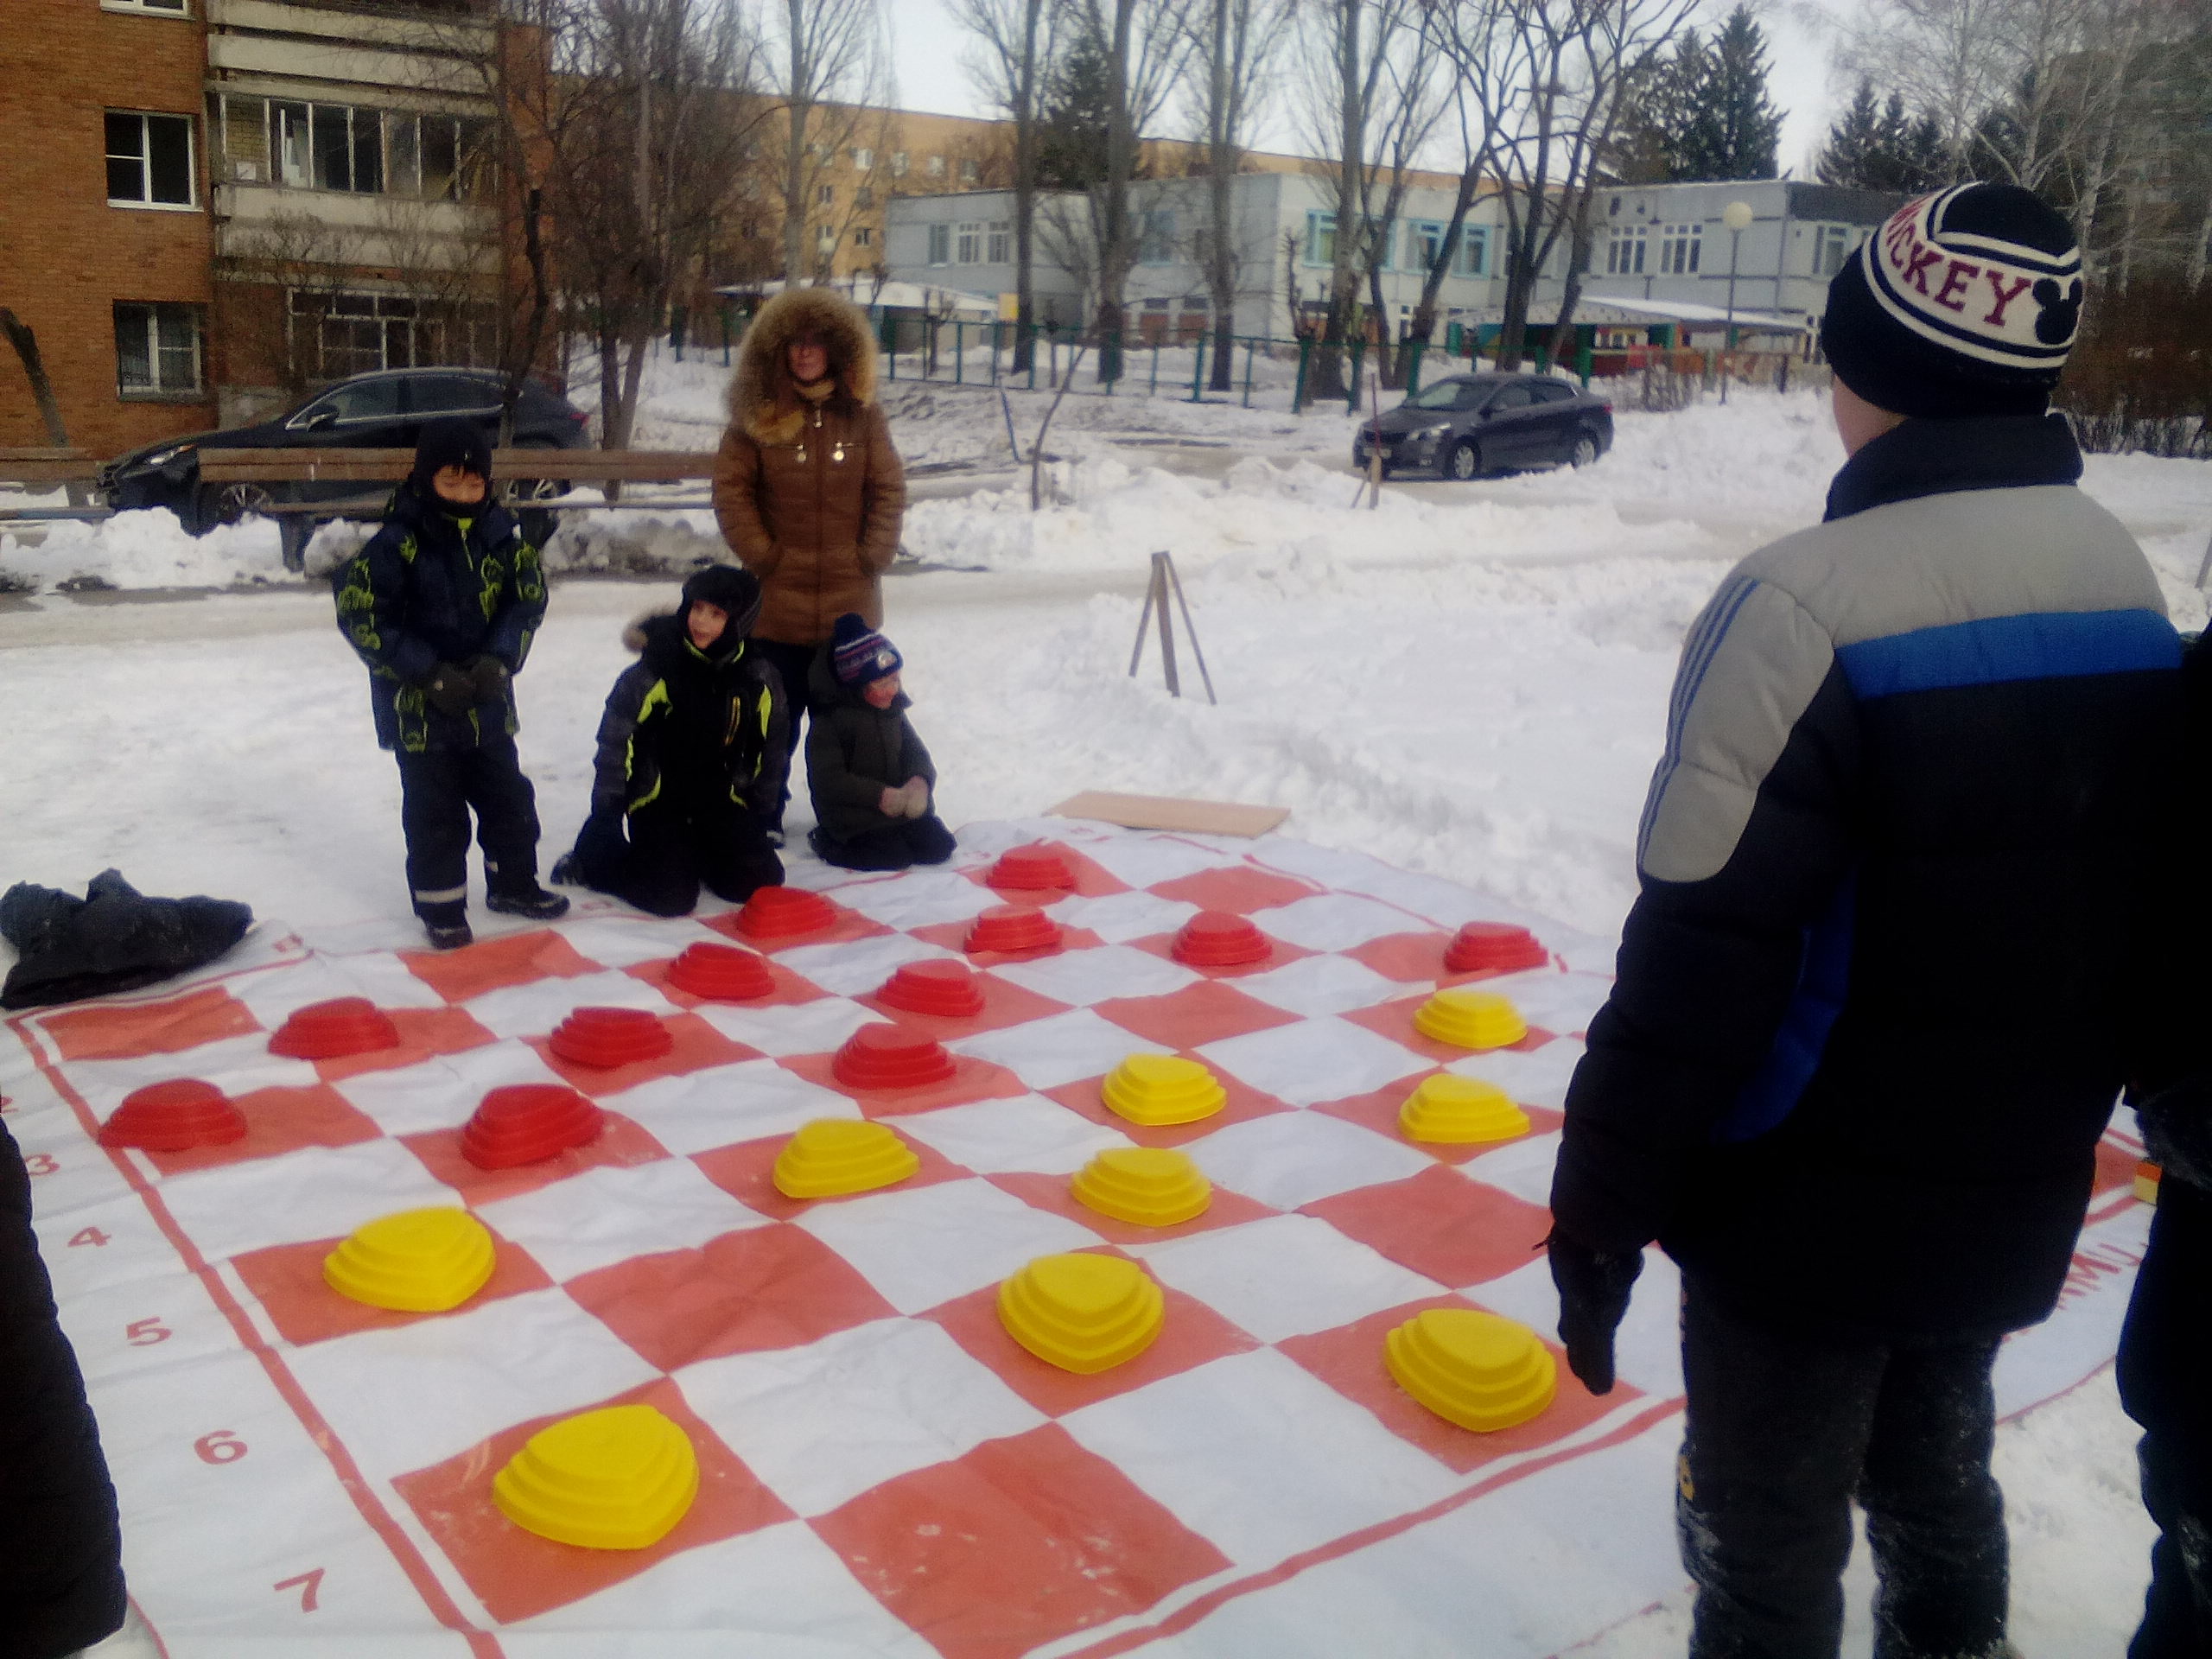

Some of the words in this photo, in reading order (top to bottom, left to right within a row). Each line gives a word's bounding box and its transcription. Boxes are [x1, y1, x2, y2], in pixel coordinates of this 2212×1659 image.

[24, 1154, 61, 1176] 3
[68, 1226, 110, 1248] 4
[125, 1316, 173, 1346] 5
[194, 1429, 250, 1465] 6
[274, 1567, 326, 1613] 7
